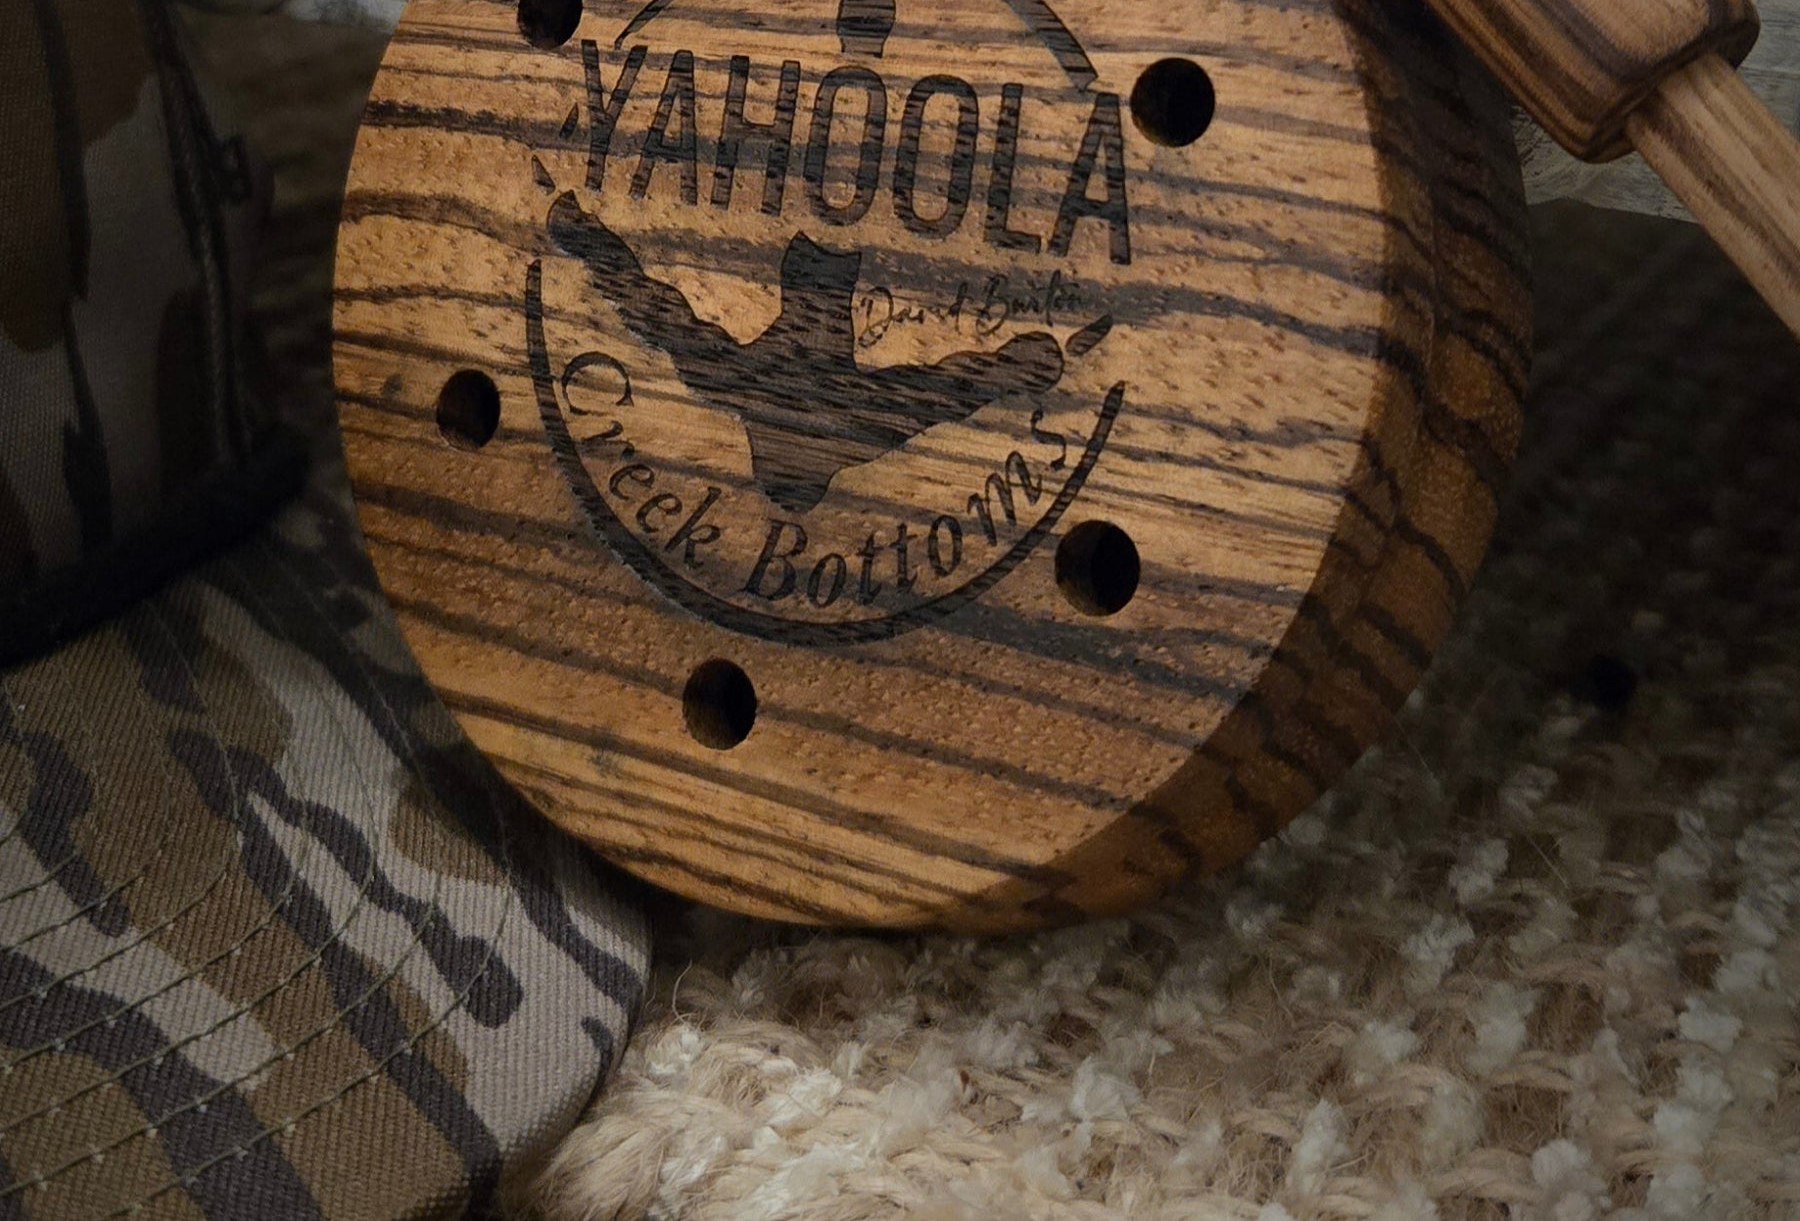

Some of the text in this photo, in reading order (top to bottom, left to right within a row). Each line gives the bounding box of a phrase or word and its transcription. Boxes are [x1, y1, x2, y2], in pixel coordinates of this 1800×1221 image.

[580, 39, 1131, 265] YAHOOLA
[561, 352, 1067, 610] Creek Bottoms
